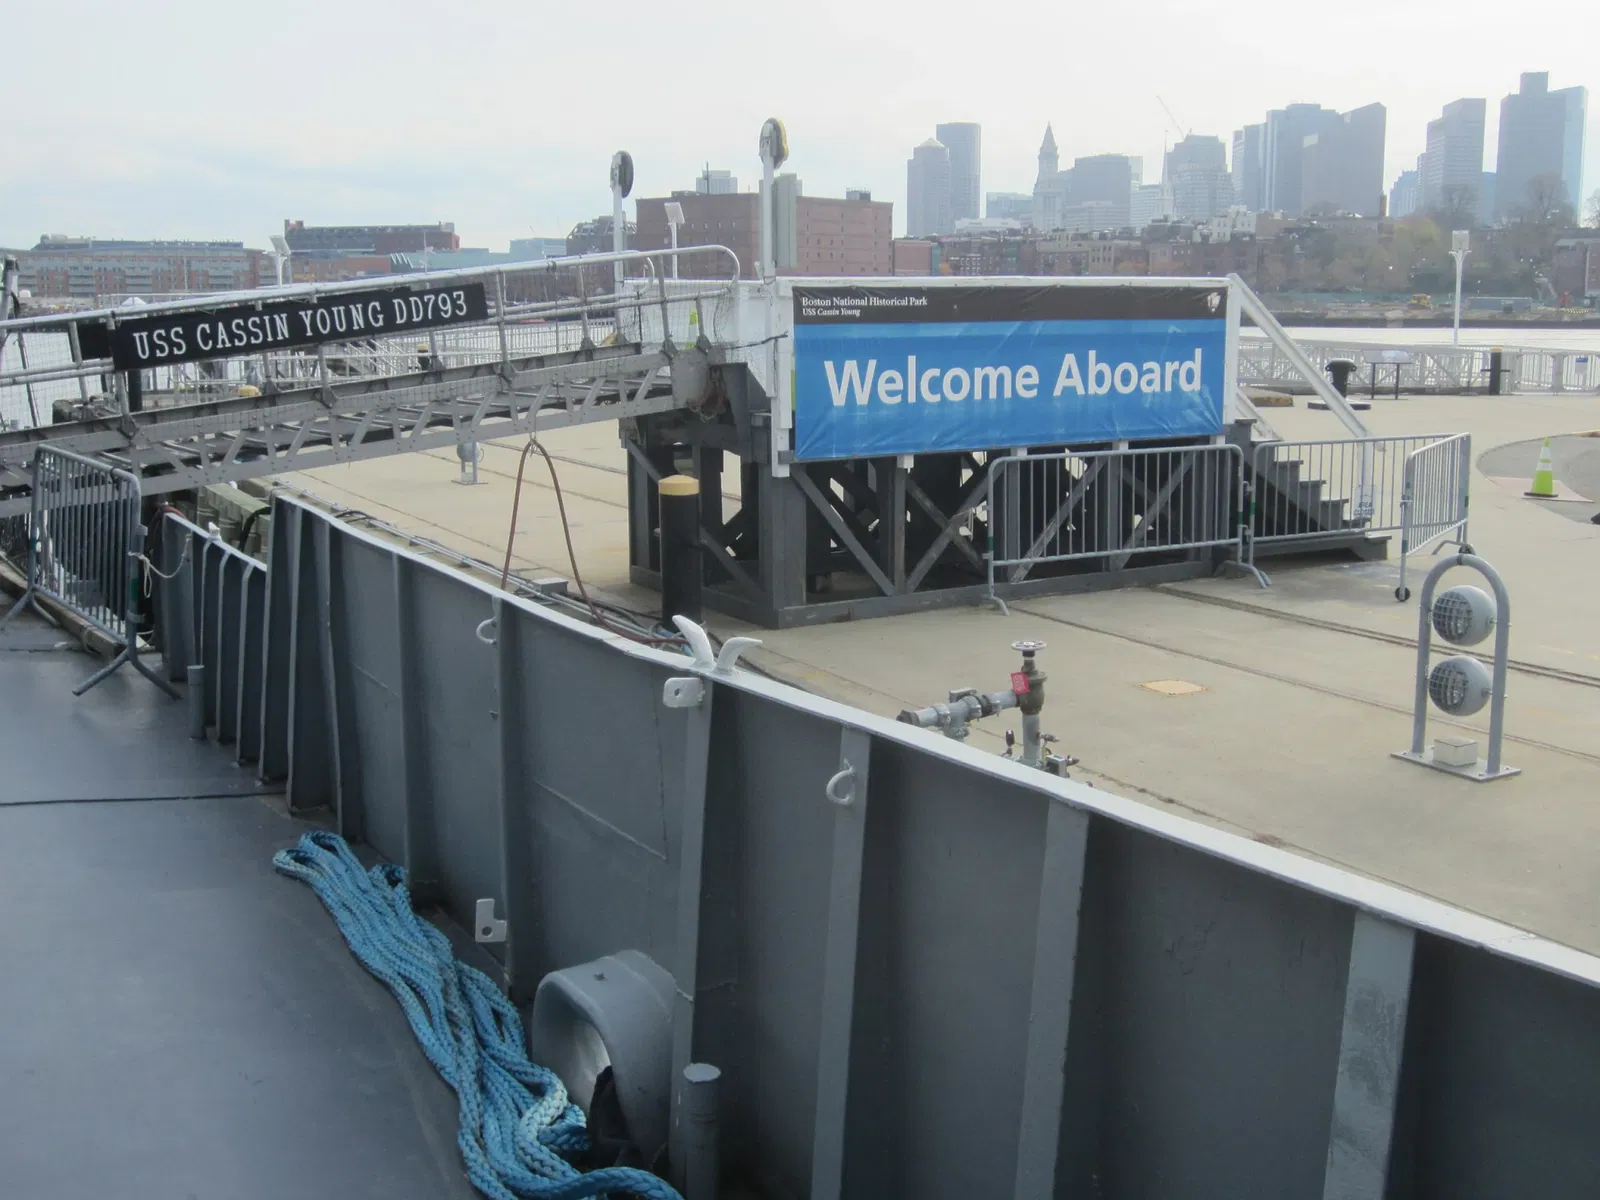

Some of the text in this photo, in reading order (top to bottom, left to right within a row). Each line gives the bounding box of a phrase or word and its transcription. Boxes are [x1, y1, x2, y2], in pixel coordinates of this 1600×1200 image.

[802, 296, 928, 306] Boston National Historical Park
[802, 307, 861, 317] USS Cassin Young
[133, 290, 468, 360] USS CASSIN YOUNG DD793
[824, 348, 1202, 406] Welcome Aboard
